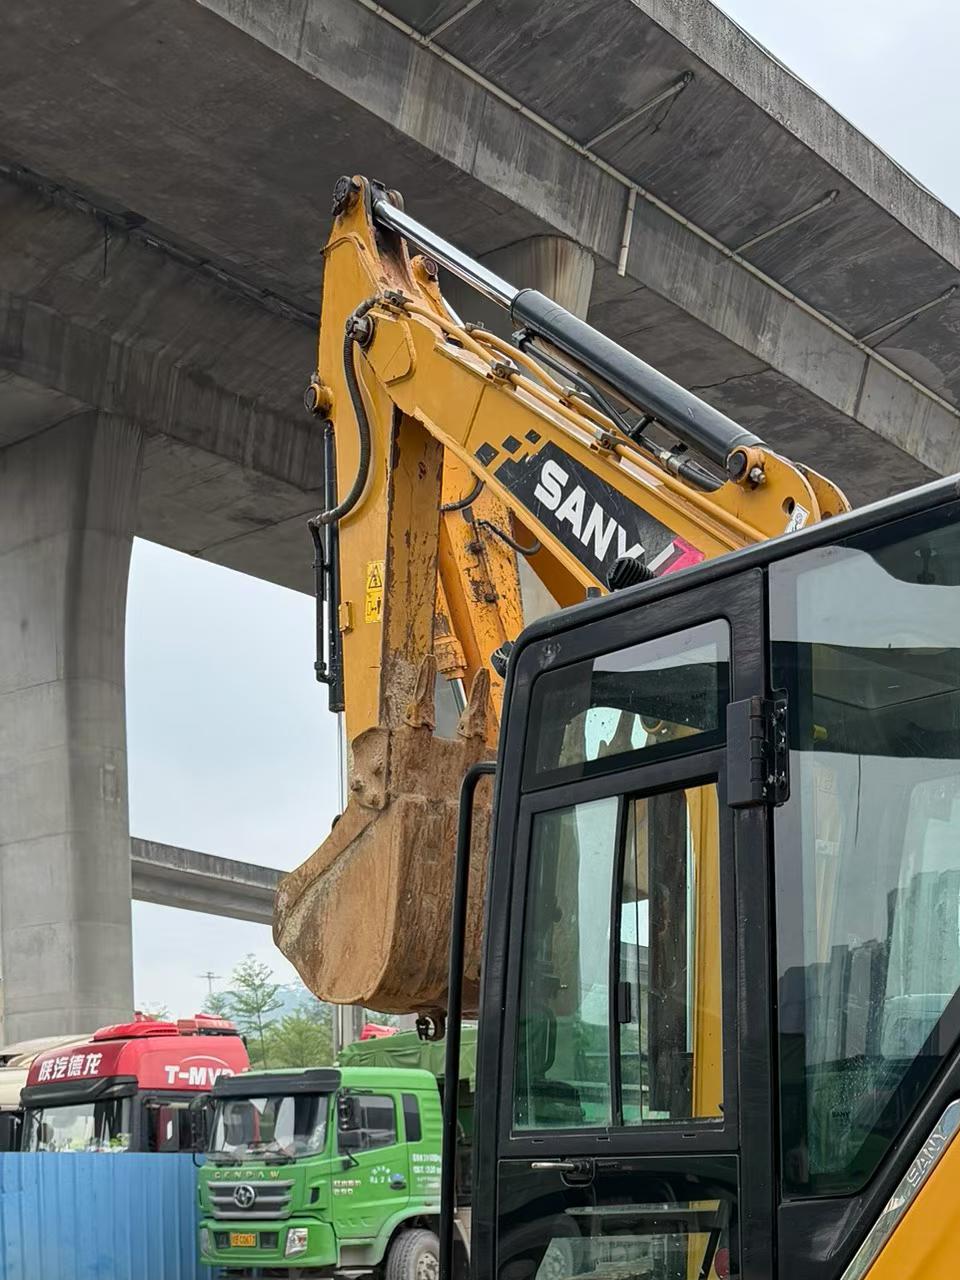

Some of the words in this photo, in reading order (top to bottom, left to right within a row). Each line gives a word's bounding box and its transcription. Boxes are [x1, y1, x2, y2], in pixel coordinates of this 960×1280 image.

[533, 459, 646, 562] SANY
[38, 1052, 103, 1082] 陕汽德龙
[906, 1125, 949, 1188] SANY
